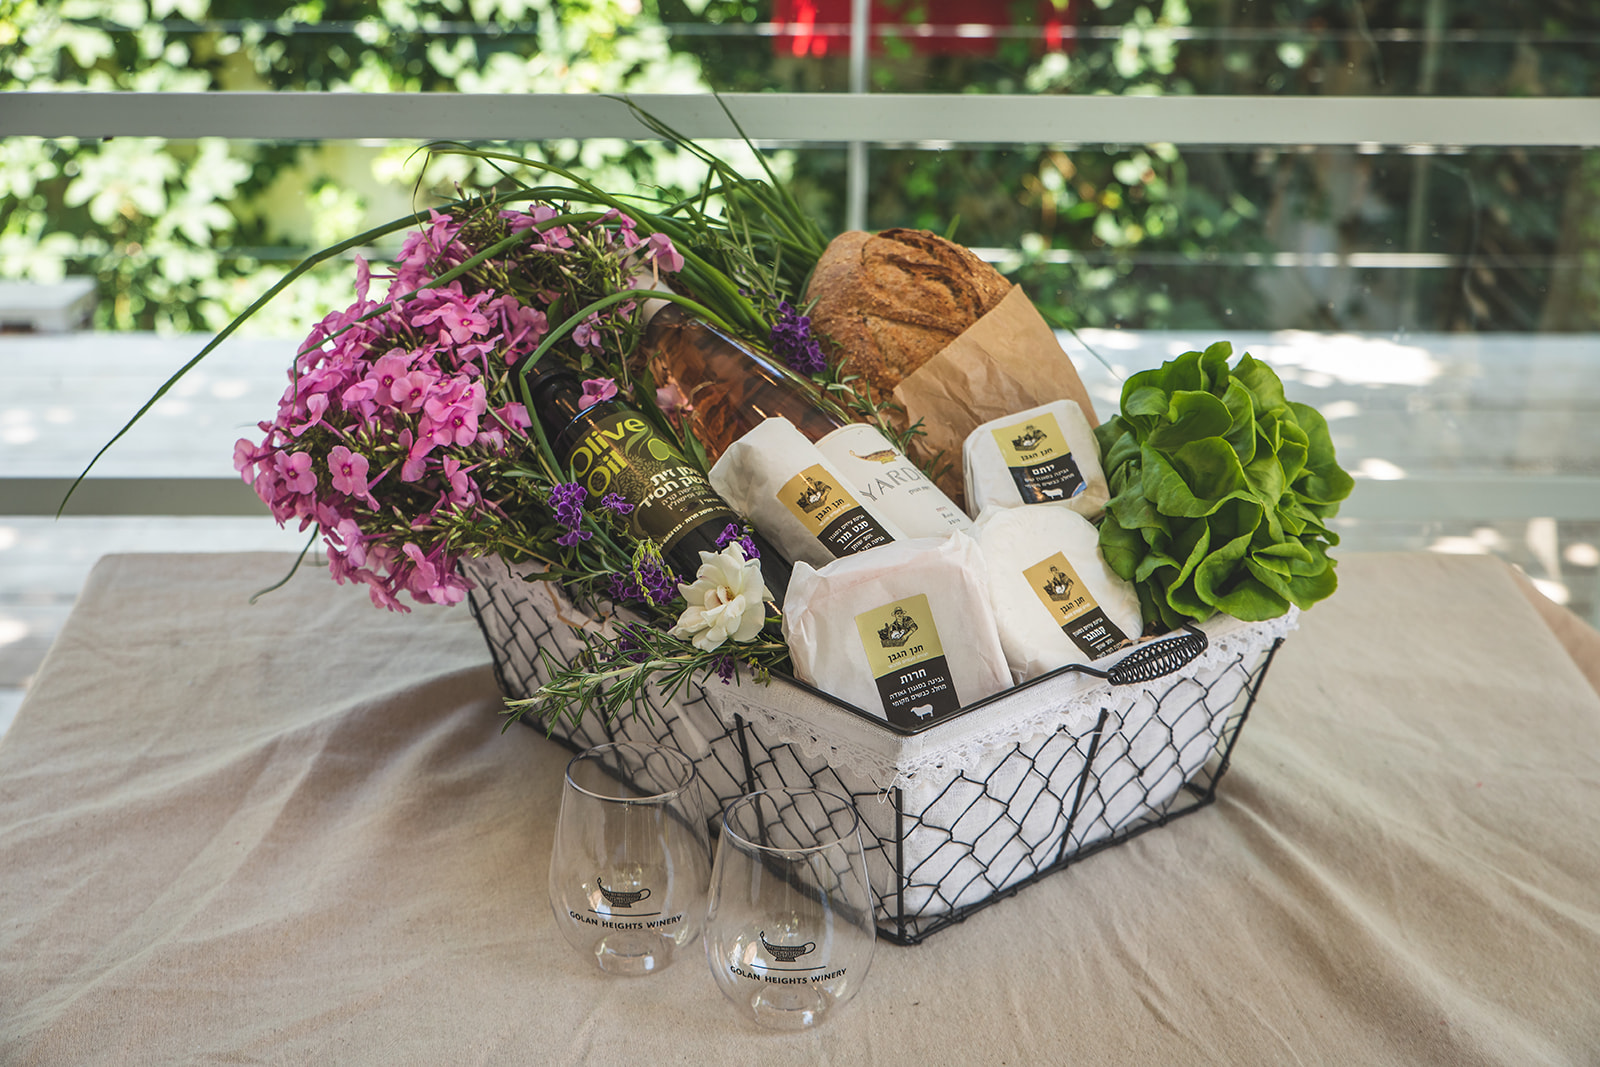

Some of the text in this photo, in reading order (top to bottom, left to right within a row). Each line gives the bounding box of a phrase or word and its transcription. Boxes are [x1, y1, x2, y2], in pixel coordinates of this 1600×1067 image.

[570, 418, 646, 478] Olive
[587, 450, 628, 497] Oil
[650, 468, 676, 487] זית
[1031, 464, 1055, 476] יותם
[638, 480, 680, 508] חסיד
[831, 498, 845, 509] חנן
[815, 505, 832, 521] הגבן
[836, 520, 869, 545] סנט מור
[1060, 602, 1075, 615] הגבן
[1082, 626, 1107, 642] קממבר
[887, 649, 908, 663] הגבן
[909, 644, 924, 656] חנן
[900, 668, 927, 685] חרות
[889, 676, 945, 701] גבינה בסגנון גאודה
[910, 690, 930, 701] כבשים
[931, 683, 947, 694] מחלב
[569, 911, 682, 930] GOLAN HEIGHTS WINERY
[730, 965, 847, 985] GOLAN HEIGHTS WINERY
